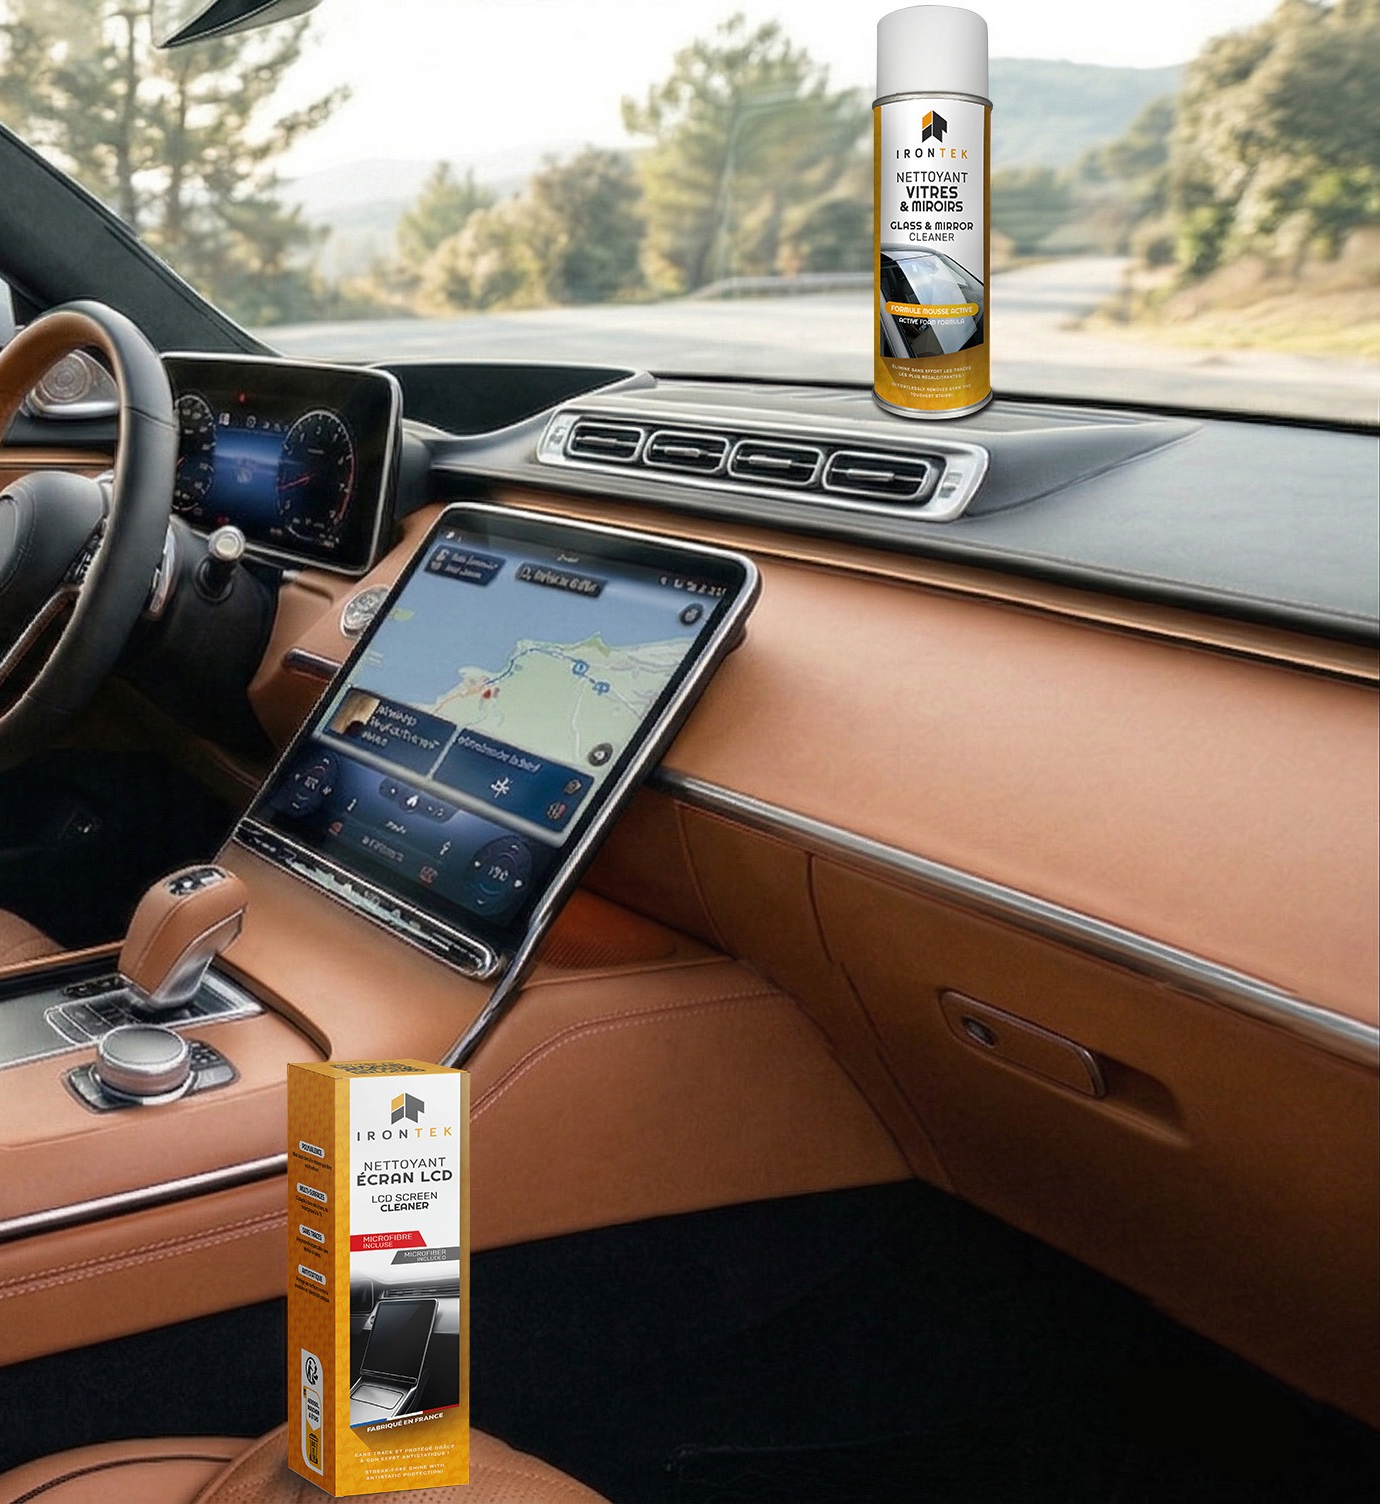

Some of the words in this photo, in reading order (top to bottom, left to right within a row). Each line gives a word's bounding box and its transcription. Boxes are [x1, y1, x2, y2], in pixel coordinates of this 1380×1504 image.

[896, 148, 968, 159] IRONTEK
[896, 171, 968, 183] NETTOYANT
[906, 186, 958, 199] VITRES
[900, 201, 909, 212] &
[912, 200, 963, 212] MIROIRS
[890, 221, 922, 230] GLASS
[925, 221, 932, 230] &
[935, 221, 974, 230] MIRROR
[909, 232, 955, 241] CLEANER
[891, 305, 920, 314] FORMULE
[950, 306, 973, 314] ACTIVE
[899, 317, 919, 325] ACTIVE
[357, 1126, 452, 1141] IRONTEK
[364, 1157, 446, 1172] NETTOYANT
[357, 1172, 414, 1186] ÉCRAN
[421, 1170, 453, 1182] LCD
[371, 1193, 393, 1204] LCD
[395, 1192, 438, 1202] SCREEN
[380, 1202, 429, 1213] CLEANER
[363, 1233, 413, 1242] MICROFIBRE
[363, 1241, 393, 1249] INCLUSE
[366, 1419, 402, 1433] FABRIQUÉ
[403, 1418, 414, 1426] EN
[415, 1412, 444, 1423] FRANCE
